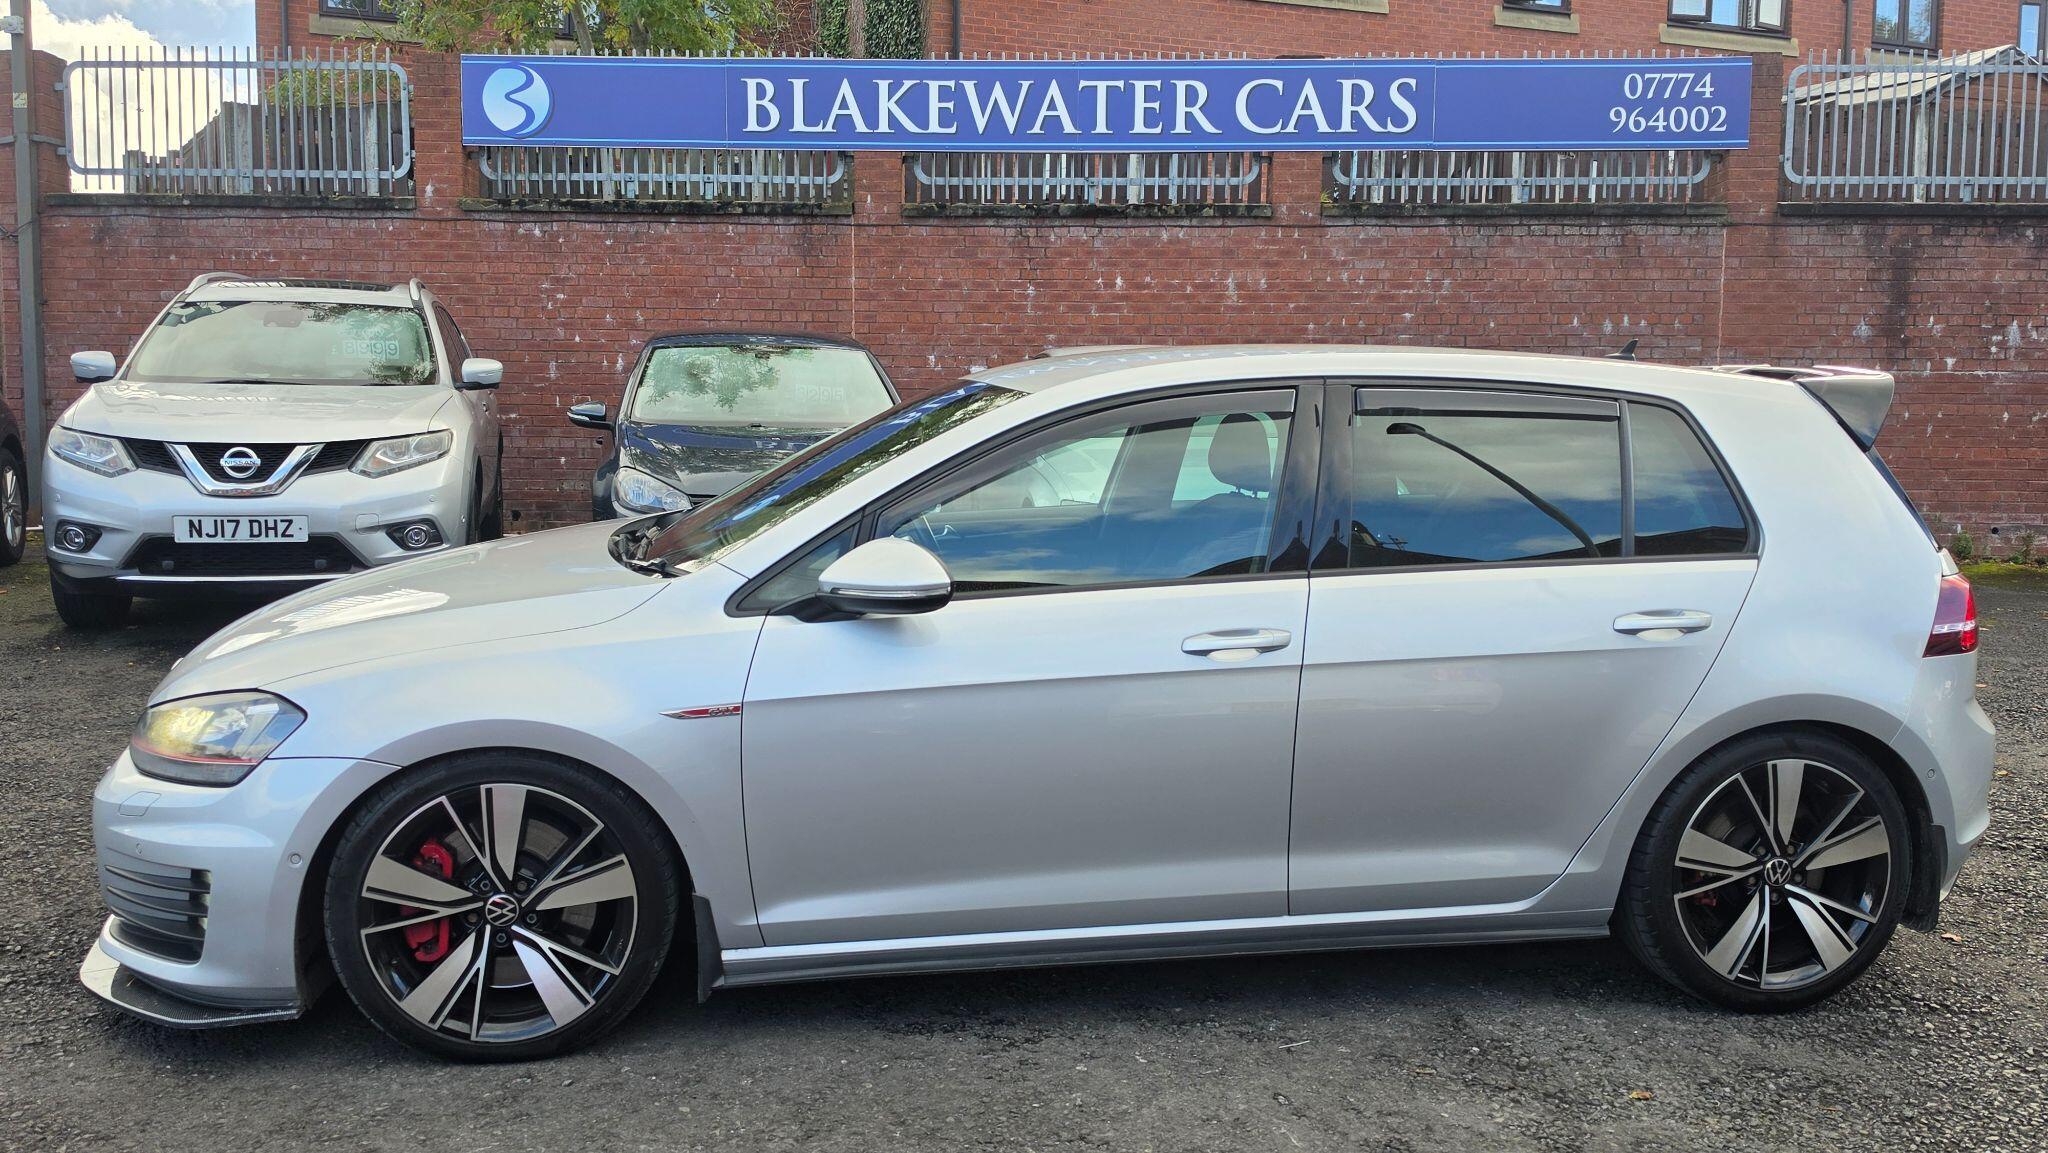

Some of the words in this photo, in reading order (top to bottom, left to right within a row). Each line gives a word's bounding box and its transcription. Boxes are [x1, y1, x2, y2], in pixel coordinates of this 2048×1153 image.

[1624, 73, 1715, 99] 07774
[741, 78, 1223, 135] BLAKEWATER
[1235, 77, 1418, 135] CARS
[1609, 105, 1727, 133] 964002
[188, 518, 241, 539] NJ17
[248, 518, 294, 539] DHZ
